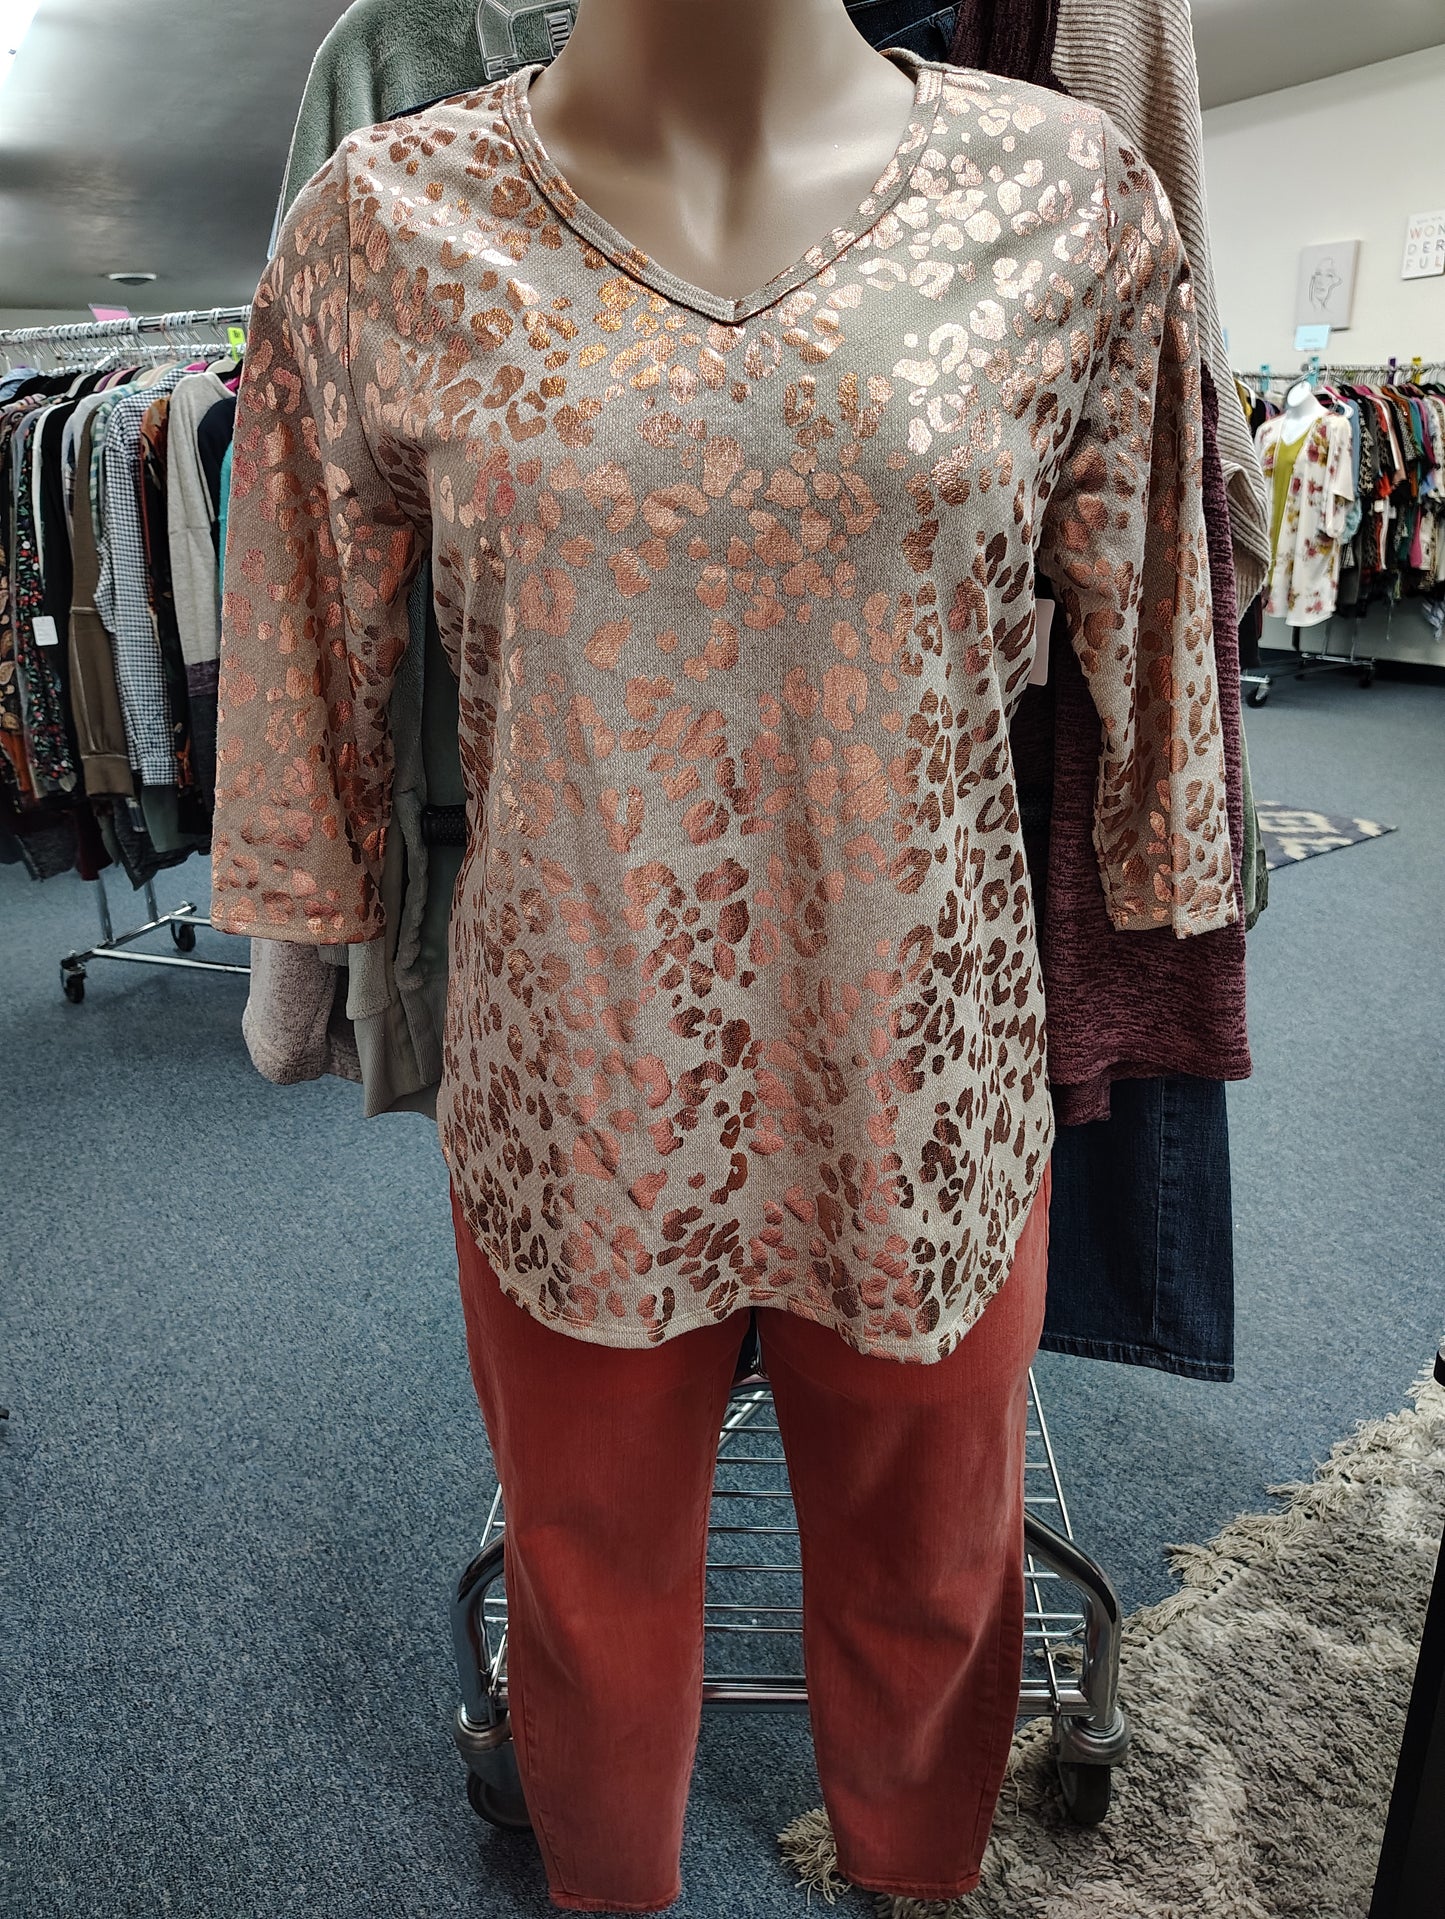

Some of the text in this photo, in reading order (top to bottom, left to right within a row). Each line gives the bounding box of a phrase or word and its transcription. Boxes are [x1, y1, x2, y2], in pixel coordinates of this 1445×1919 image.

[1409, 223, 1445, 239] WON
[1407, 239, 1445, 255] DER
[1405, 256, 1442, 269] FUL
